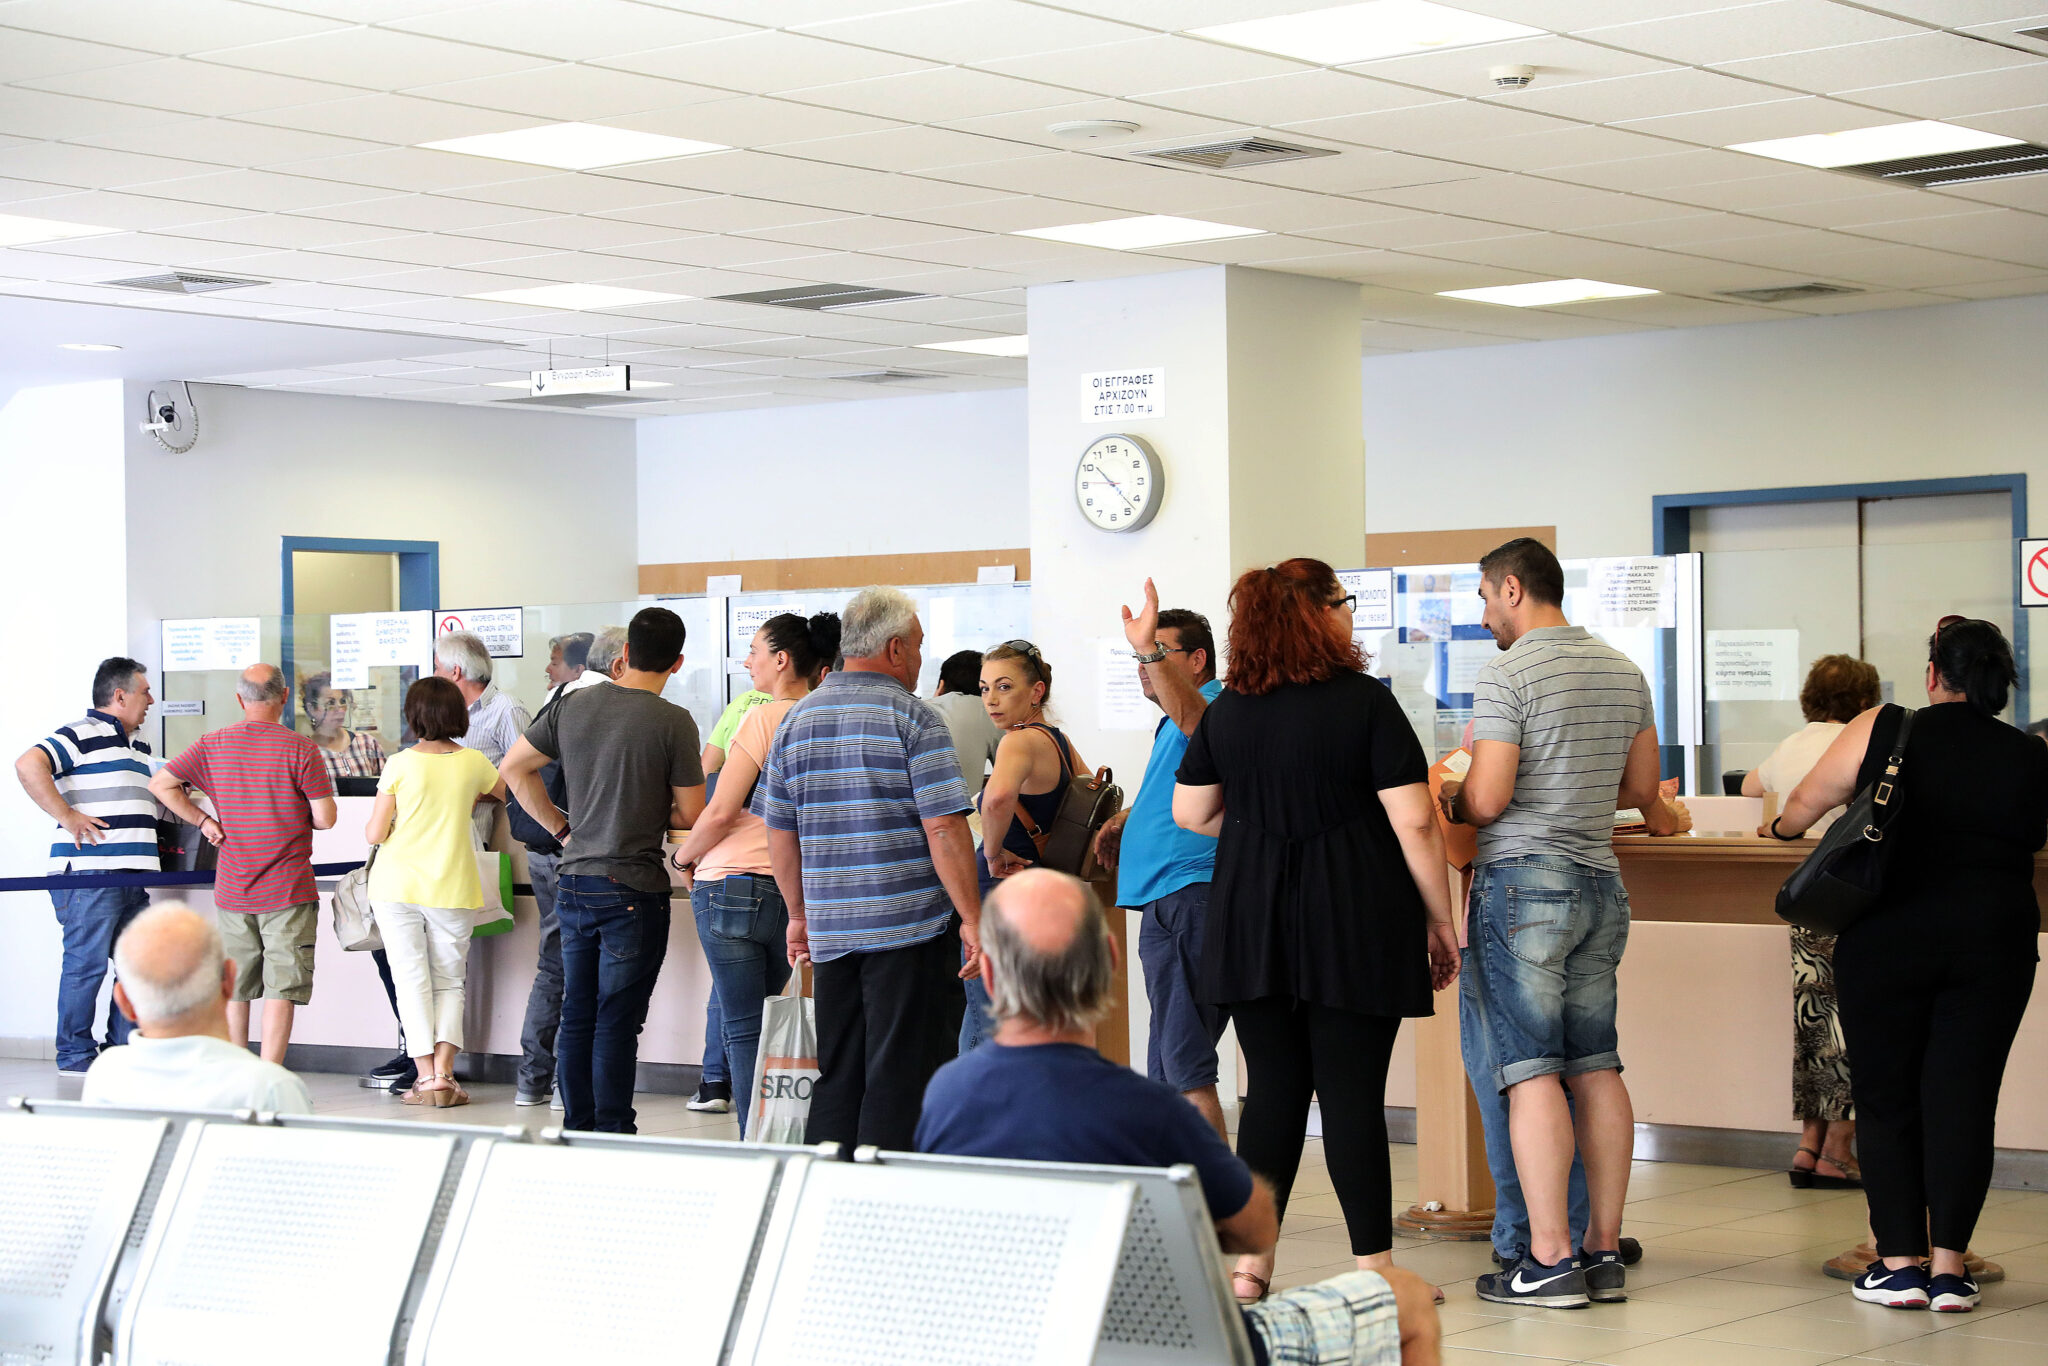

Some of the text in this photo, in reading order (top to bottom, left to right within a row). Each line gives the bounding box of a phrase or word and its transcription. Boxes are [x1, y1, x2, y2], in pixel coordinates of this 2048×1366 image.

[1093, 374, 1154, 388] ΟΙ ΕΓΓΡΑΦΕΣ
[1098, 389, 1147, 401] ΑΡΧΙΖΟΥΝ
[1094, 404, 1113, 416] ΣΤΙΣ
[1116, 403, 1135, 414] 7.00
[1106, 445, 1117, 453] 12
[1124, 449, 1129, 457] 1
[1083, 464, 1094, 472] 10
[1132, 460, 1140, 469] 2
[1082, 481, 1089, 490] 9
[1137, 477, 1144, 486] 3
[1086, 498, 1093, 507] 8
[1132, 494, 1141, 503] 4
[1096, 509, 1103, 518] 7
[1124, 507, 1132, 516] 5
[1110, 513, 1117, 522] 6
[737, 610, 768, 621] ΕΓΓΡΑΦΕΣ
[1602, 1255, 1616, 1263] NIKE
